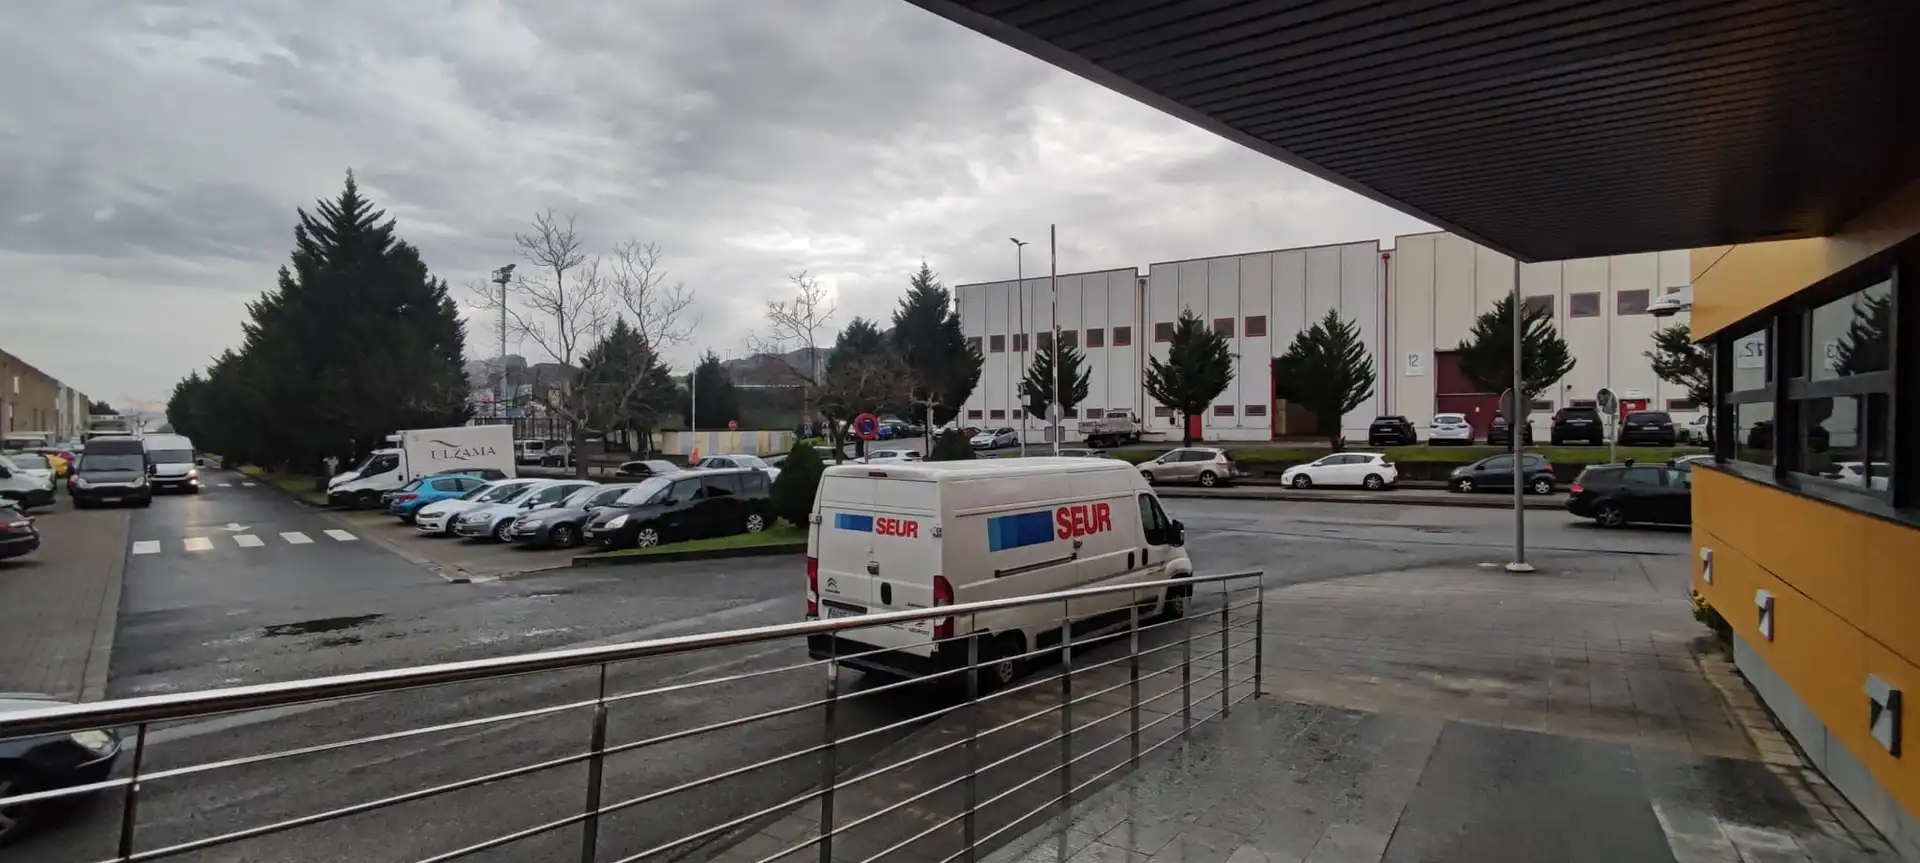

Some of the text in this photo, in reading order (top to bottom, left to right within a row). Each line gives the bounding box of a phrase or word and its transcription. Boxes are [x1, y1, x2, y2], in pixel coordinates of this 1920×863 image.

[1408, 353, 1419, 367] 12
[875, 517, 919, 538] SEUR
[1056, 503, 1112, 540] SEUR
